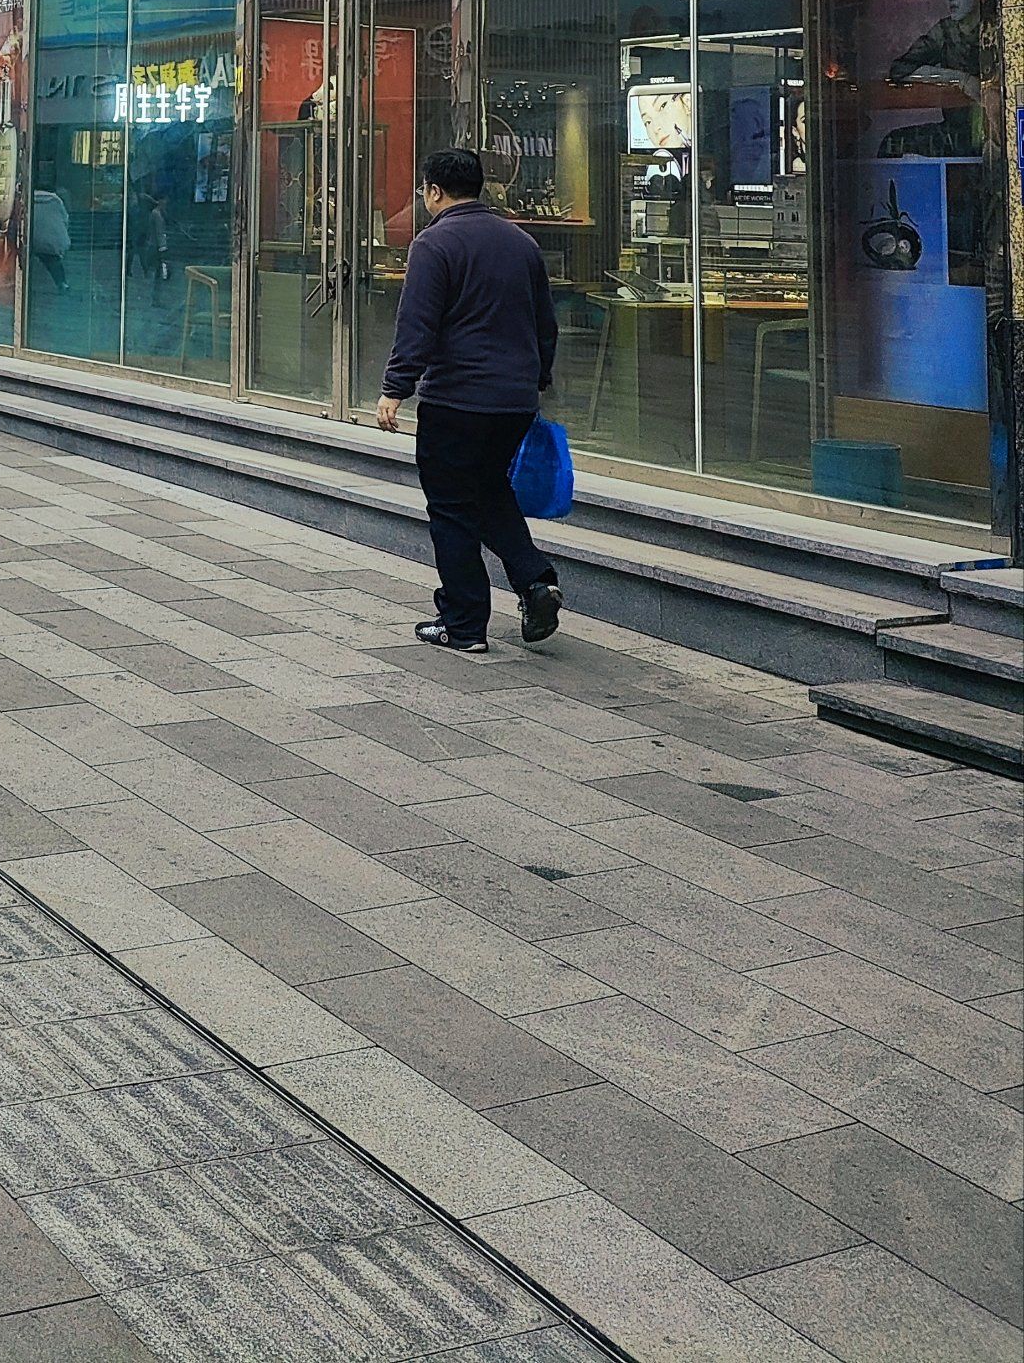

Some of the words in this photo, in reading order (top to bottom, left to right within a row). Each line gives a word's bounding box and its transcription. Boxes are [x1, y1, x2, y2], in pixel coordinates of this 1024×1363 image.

[113, 82, 212, 125] 周生生华宇
